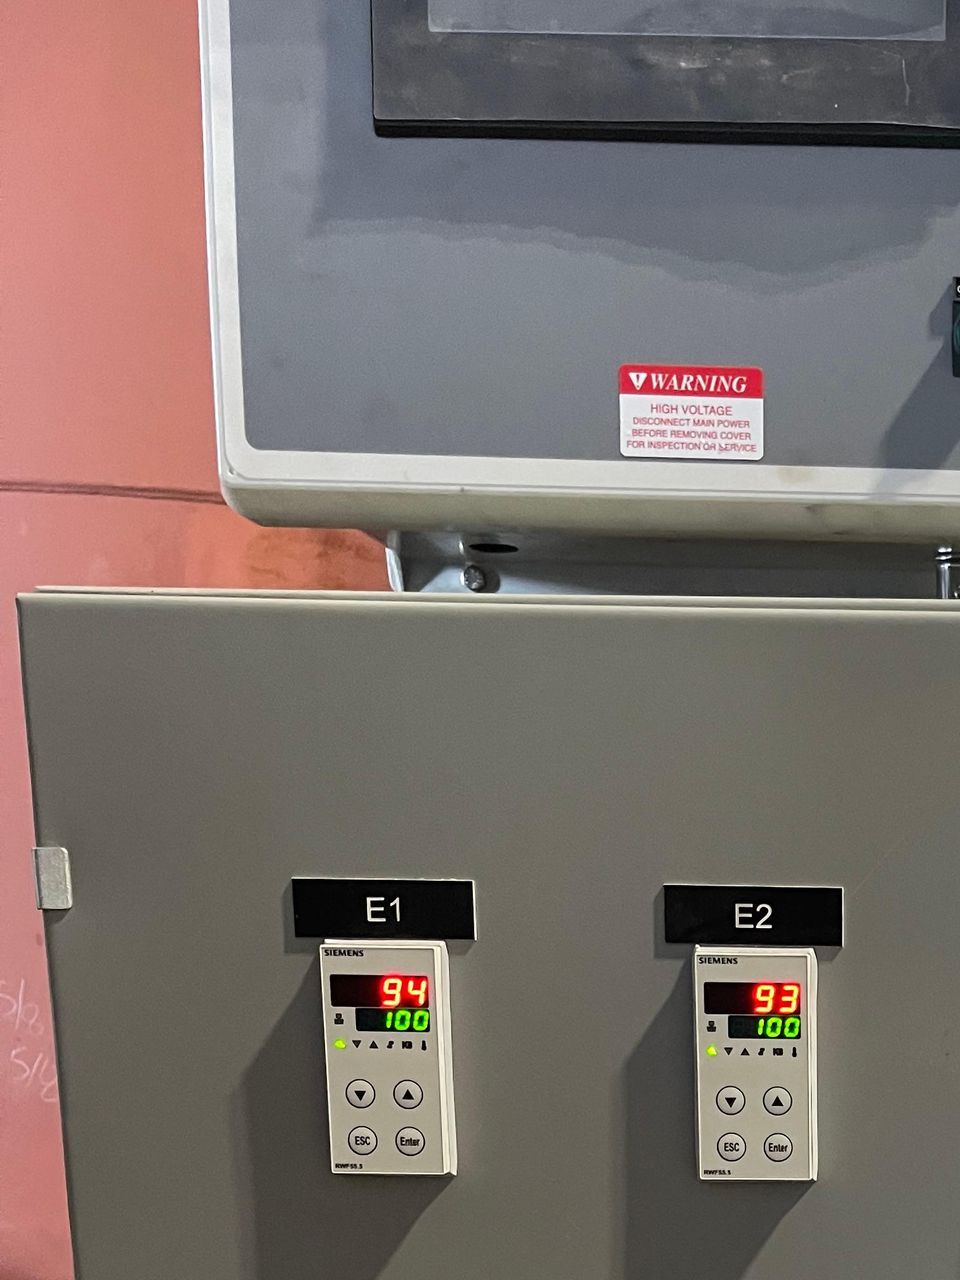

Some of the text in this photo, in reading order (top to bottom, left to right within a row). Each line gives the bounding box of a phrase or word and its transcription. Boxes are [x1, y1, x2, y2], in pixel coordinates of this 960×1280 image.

[651, 373, 748, 393] WARNING
[650, 404, 733, 416] HIGH VOLTAGE
[633, 417, 750, 428] DISCONNECT MAIN POWER
[632, 429, 752, 440] BEFORE REMOVING COVER
[626, 440, 757, 453] FOR INSPECTION OR SERVICE
[365, 896, 401, 922] E1
[735, 903, 773, 929] E2
[324, 949, 364, 957] SIEMENS
[698, 957, 739, 965] SIEMENS
[383, 978, 427, 1006] 94
[755, 985, 799, 1013] 93
[385, 1010, 430, 1031] 100
[757, 1017, 800, 1038] 100
[354, 1136, 371, 1146] ESC
[400, 1136, 420, 1147] Enter
[724, 1142, 740, 1152] ESC
[768, 1143, 788, 1153] Enter
